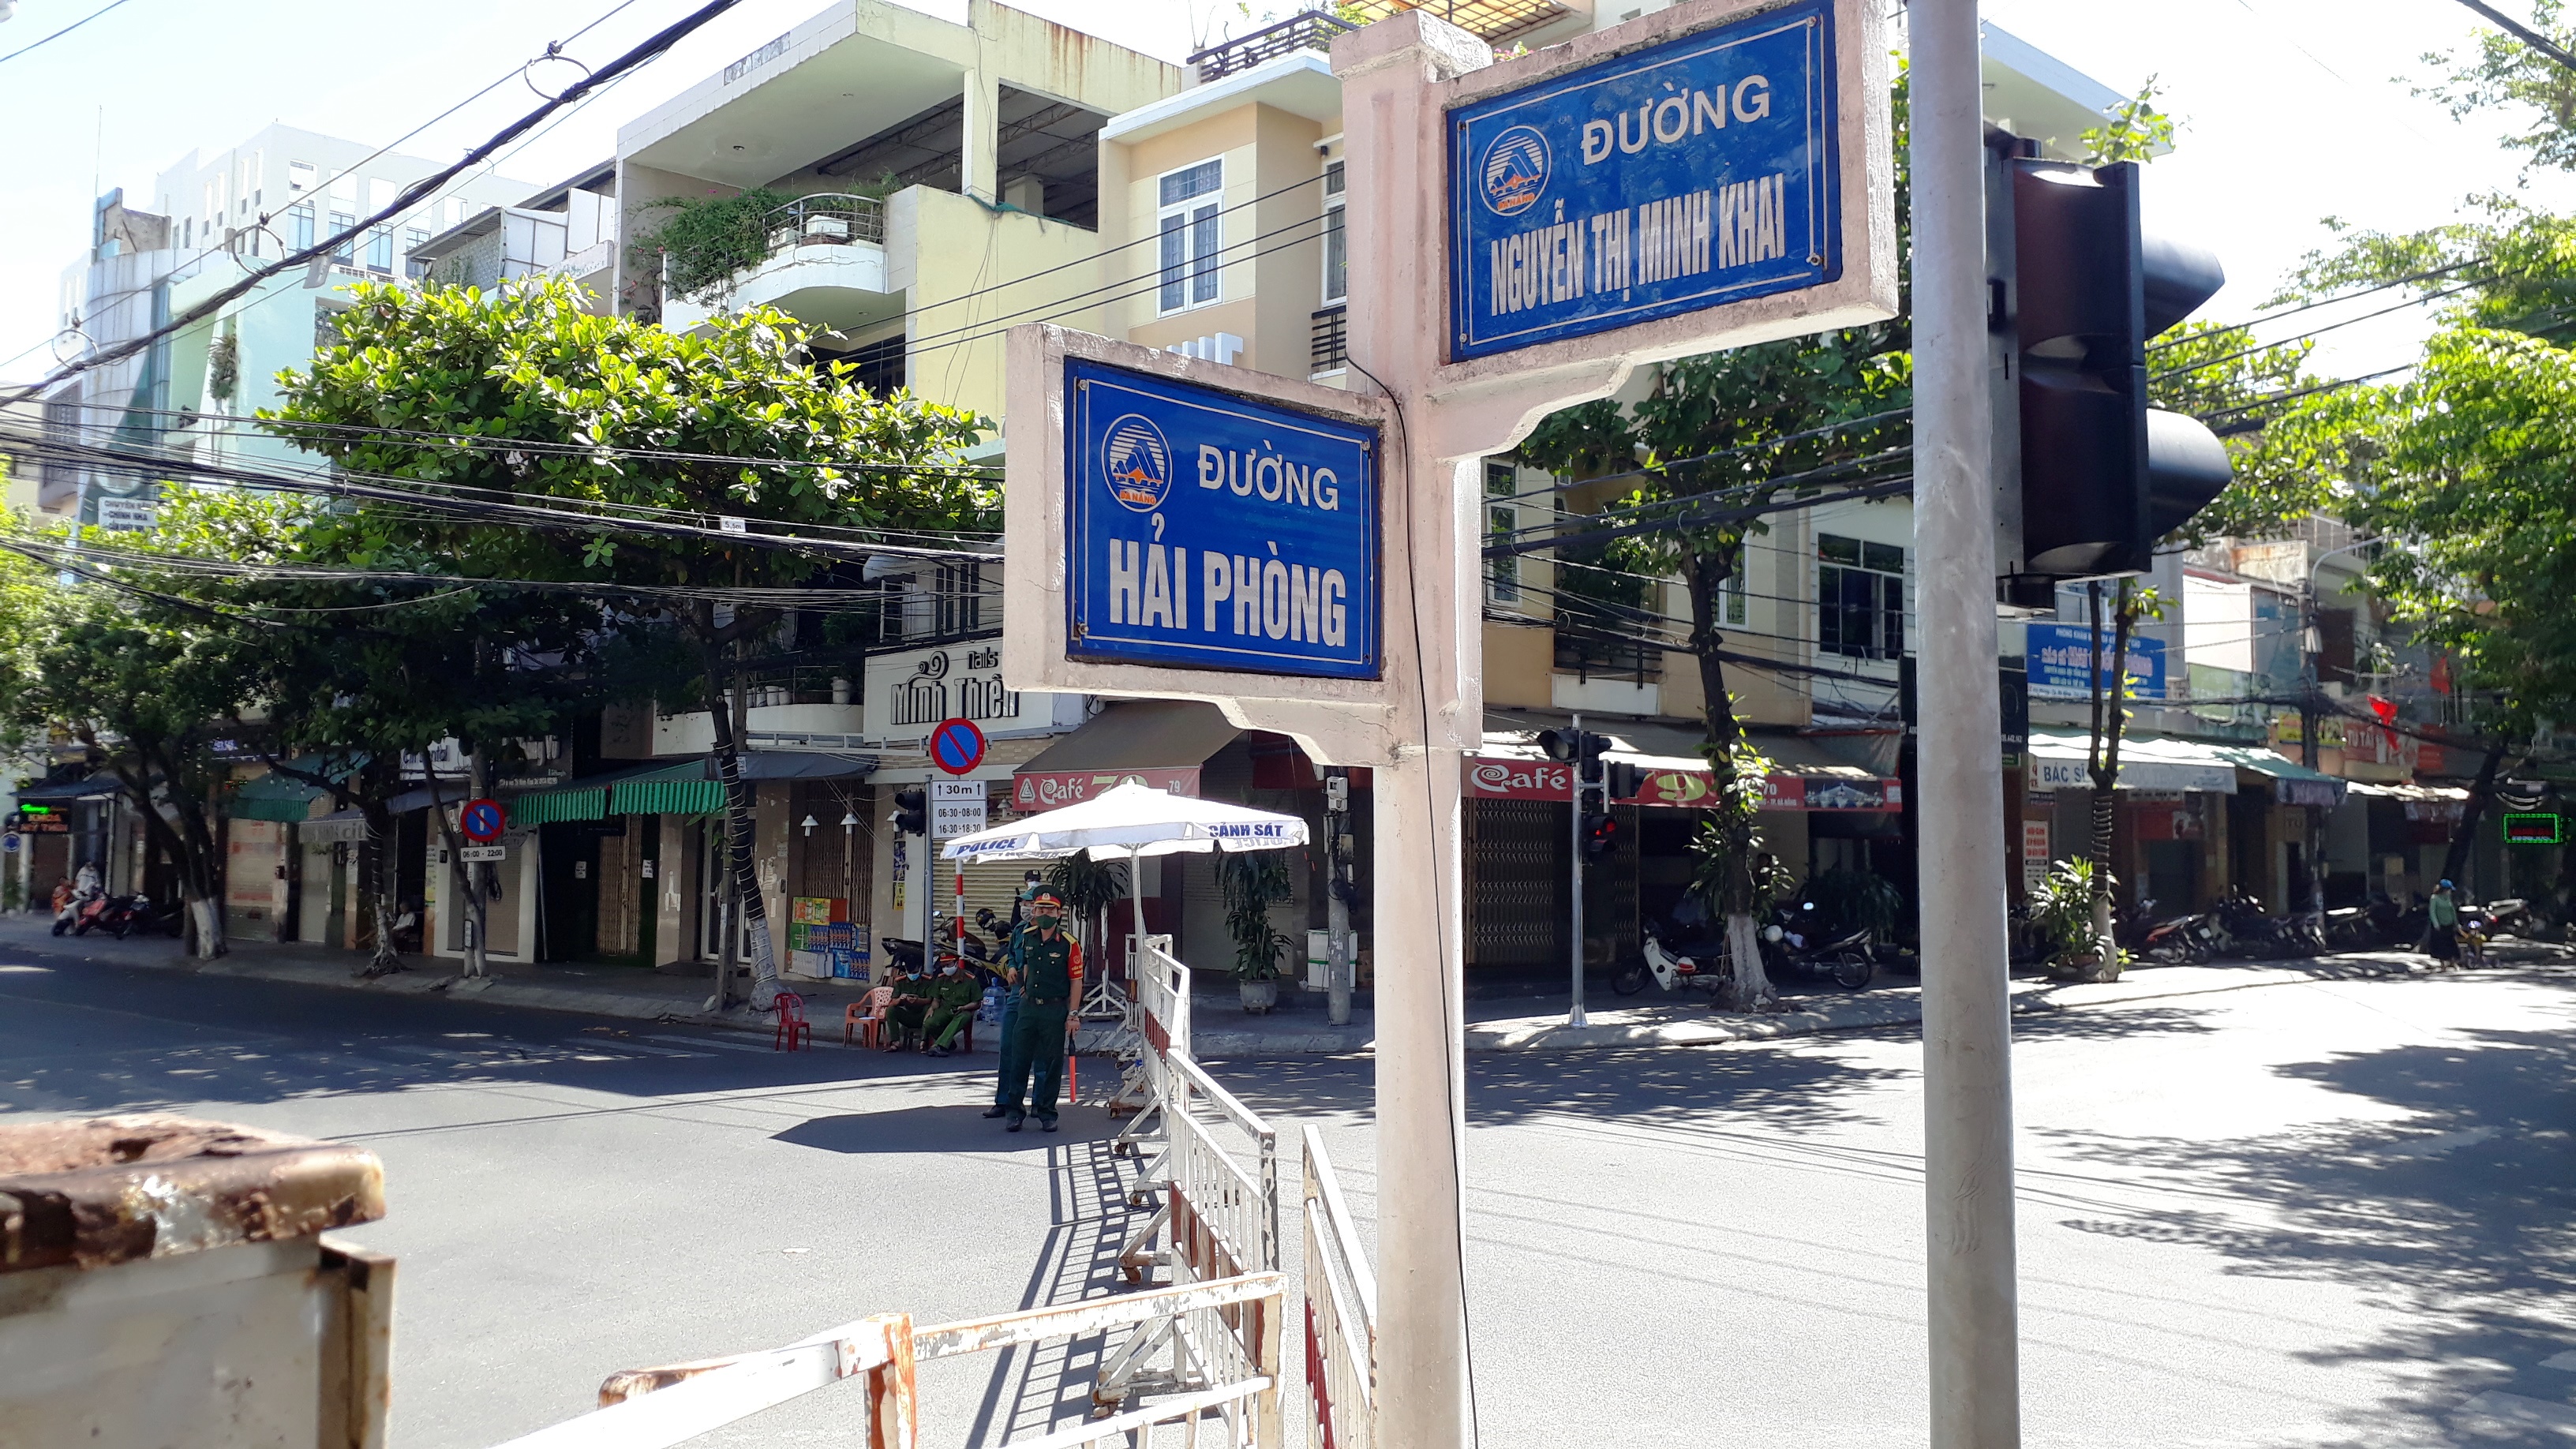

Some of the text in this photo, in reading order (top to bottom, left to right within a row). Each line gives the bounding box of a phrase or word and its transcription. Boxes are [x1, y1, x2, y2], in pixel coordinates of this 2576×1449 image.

[1581, 75, 1770, 165] ĐƯỜNG
[1491, 173, 1785, 316] NGUYỄN THỊ MINH KHAI
[1197, 439, 1339, 511] ĐƯỜNG
[1109, 513, 1346, 647] HẢI PHÒNG
[967, 646, 999, 669] nails
[890, 680, 947, 724] Minh
[1470, 762, 1567, 792] Café
[2043, 761, 2069, 783] BÁC
[1039, 777, 1084, 805] Café
[1168, 780, 1181, 794] 79
[1253, 822, 1284, 837] SÁT
[487, 848, 503, 857] 22:00
[956, 837, 1018, 856] POLICE
